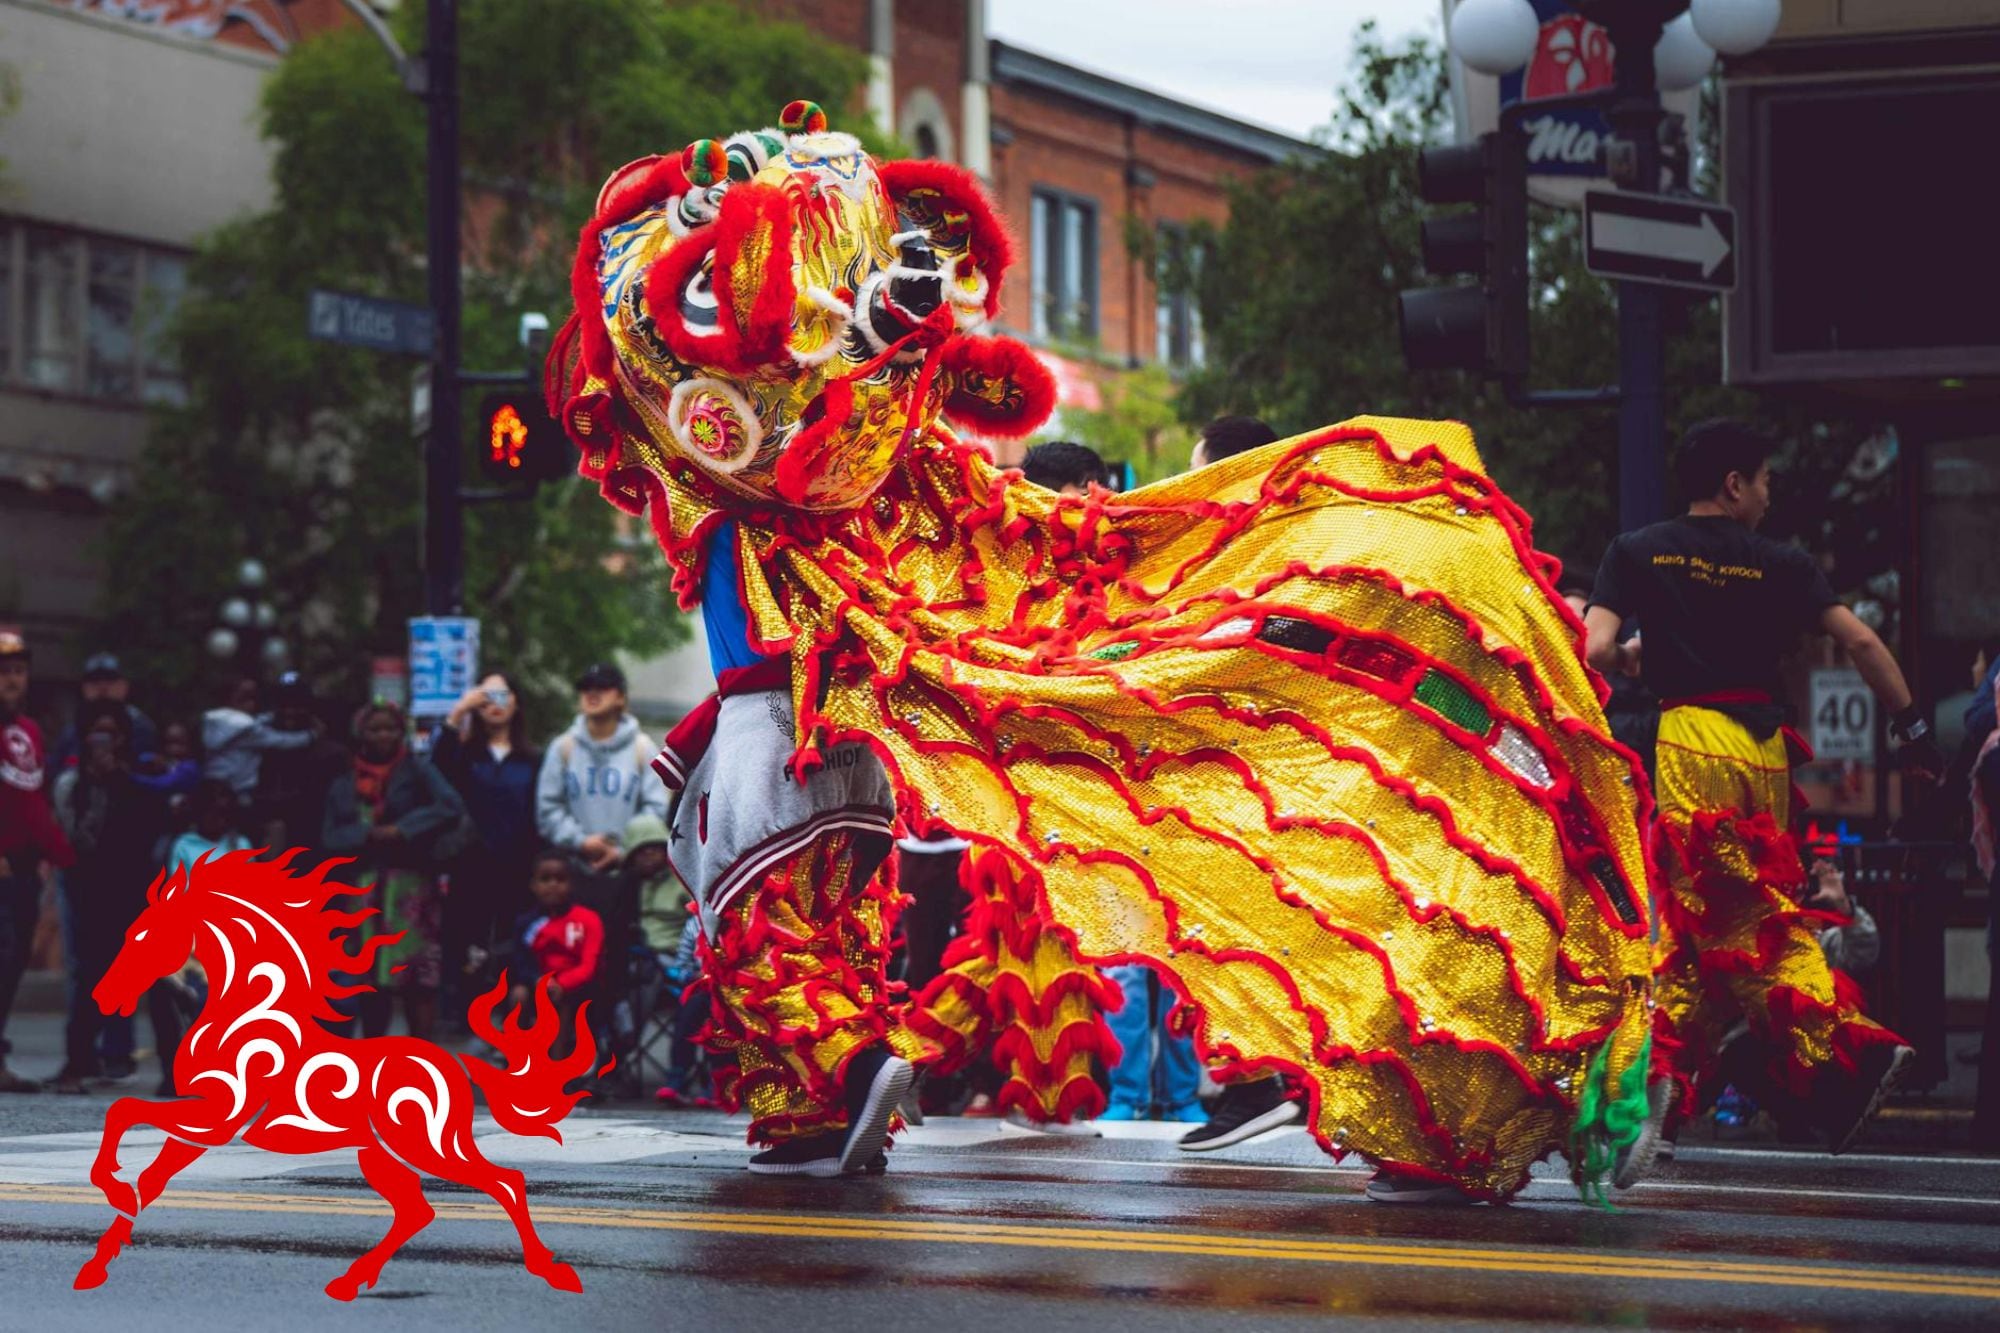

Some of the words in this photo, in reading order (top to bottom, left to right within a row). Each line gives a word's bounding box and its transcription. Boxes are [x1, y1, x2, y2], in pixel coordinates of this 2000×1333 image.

[342, 299, 396, 342] Yates
[1652, 555, 1686, 566] HUNG
[1719, 565, 1763, 580] KWOON
[1817, 692, 1869, 738] 40
